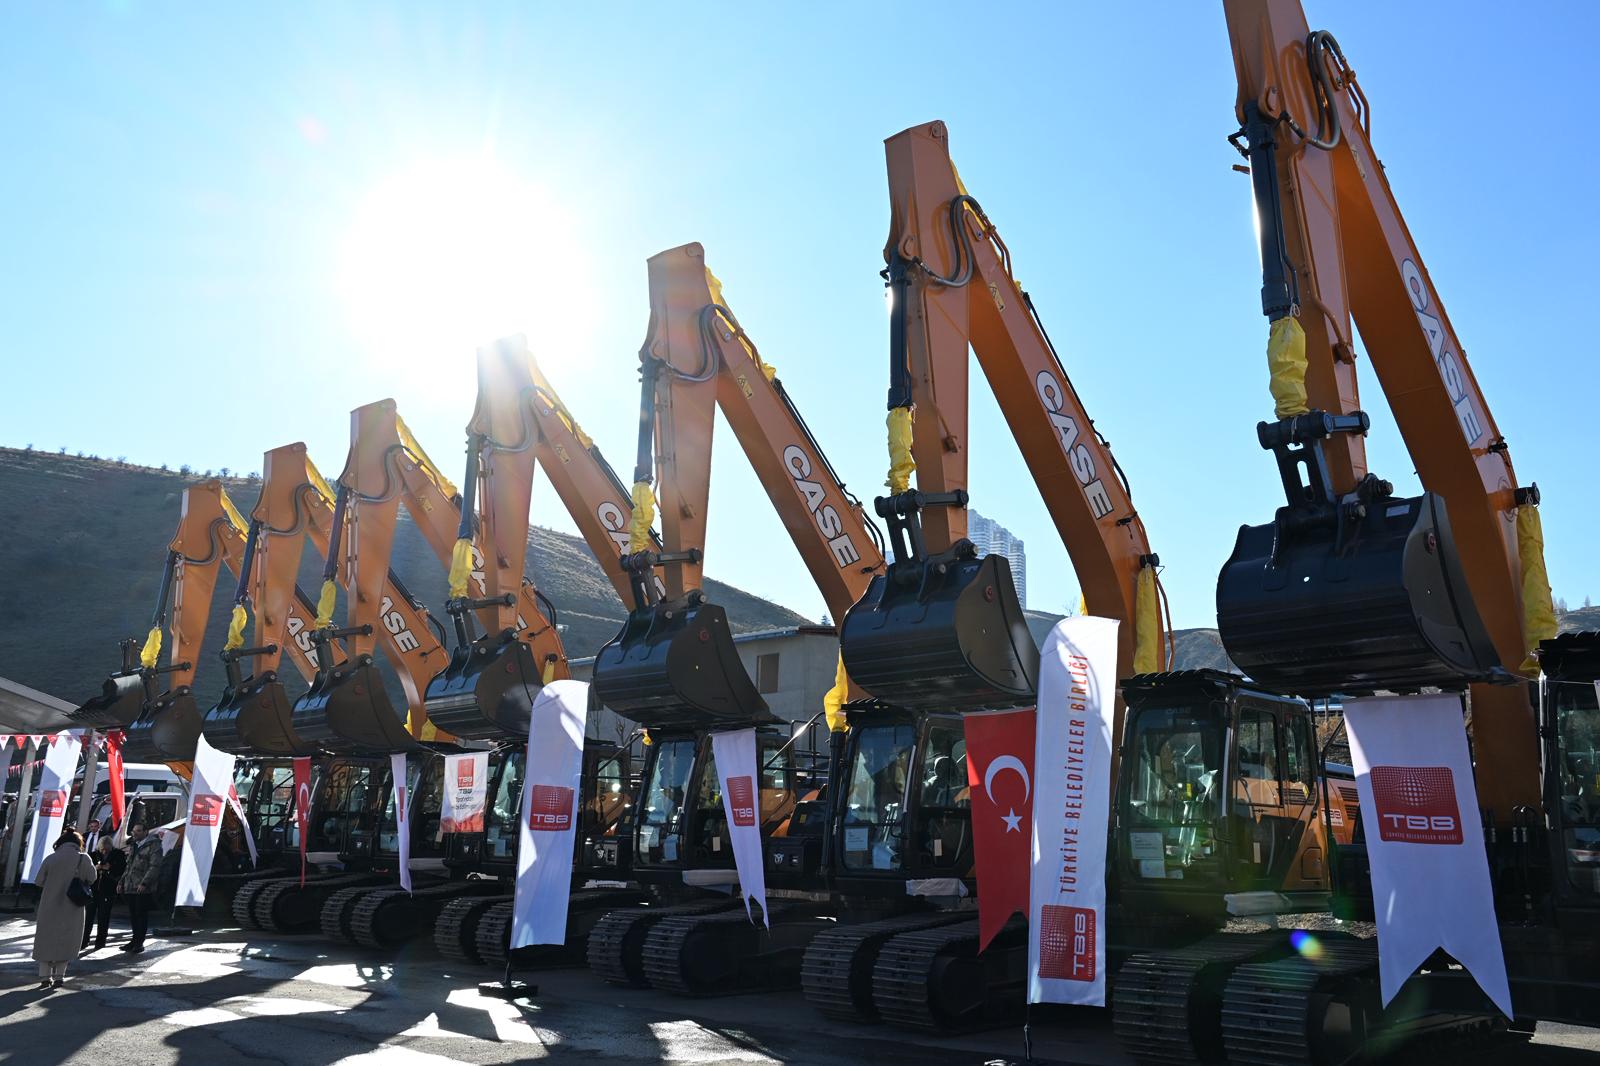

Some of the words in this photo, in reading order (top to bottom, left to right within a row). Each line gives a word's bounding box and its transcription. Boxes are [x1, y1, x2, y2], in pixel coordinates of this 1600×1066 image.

[1401, 257, 1483, 446] CASE
[1035, 368, 1114, 520] CASE
[783, 443, 861, 569] CASE
[287, 603, 320, 669] ASE
[379, 595, 420, 653] ASE
[1067, 655, 1089, 711] BİRLİĞİ
[1064, 719, 1086, 819] BELEDİYELER
[193, 813, 217, 821] TBB
[533, 813, 568, 824] TBB
[733, 807, 753, 818] TBB
[1383, 813, 1457, 831] TBB
[1060, 828, 1079, 893] TÜRKİYE
[1073, 913, 1086, 976] TBB
